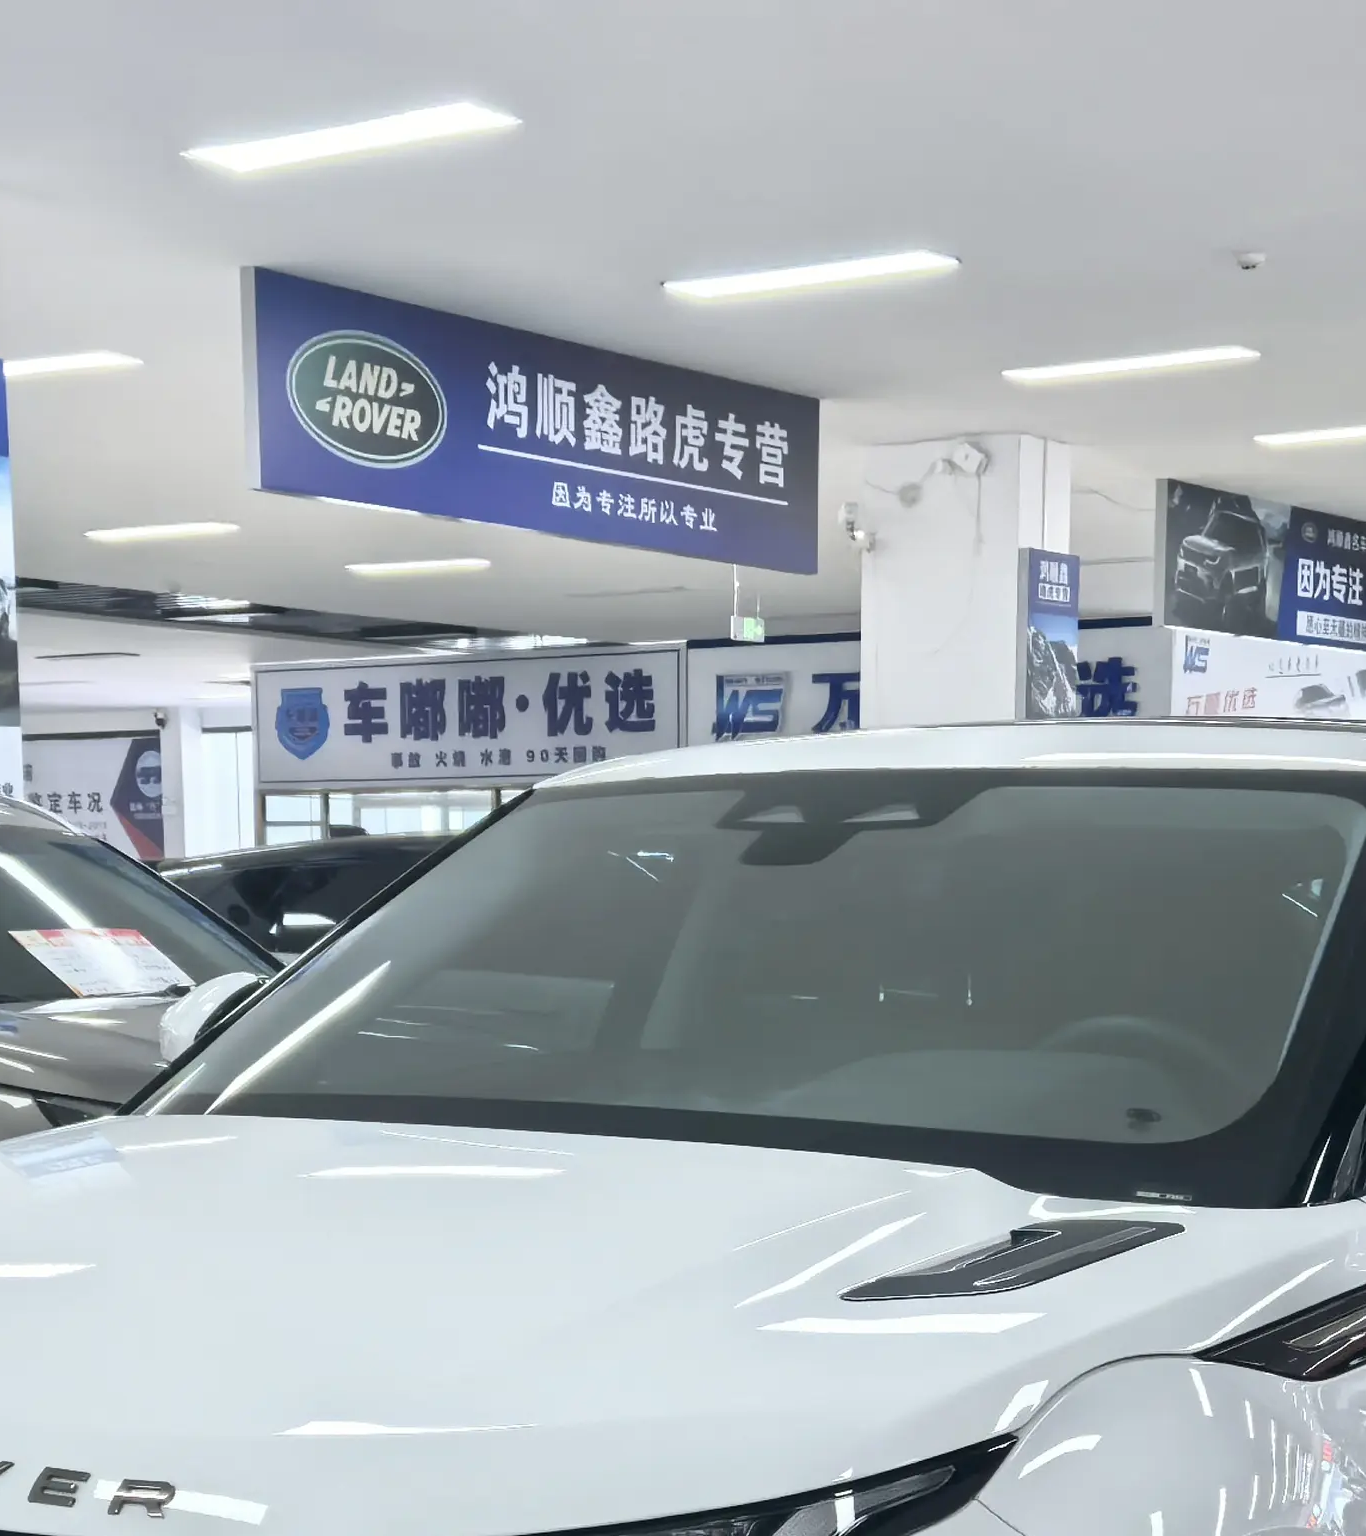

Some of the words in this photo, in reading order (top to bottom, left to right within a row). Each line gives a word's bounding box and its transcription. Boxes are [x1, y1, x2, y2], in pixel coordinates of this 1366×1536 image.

[323, 354, 399, 398] LAND
[331, 397, 422, 444] ROVER
[485, 361, 789, 488] 鸿顺鑫路虎专营
[550, 480, 718, 533] 因为专注所以专业
[1297, 557, 1365, 607] 因为专注
[343, 668, 657, 743] 车嘟嘟·优选
